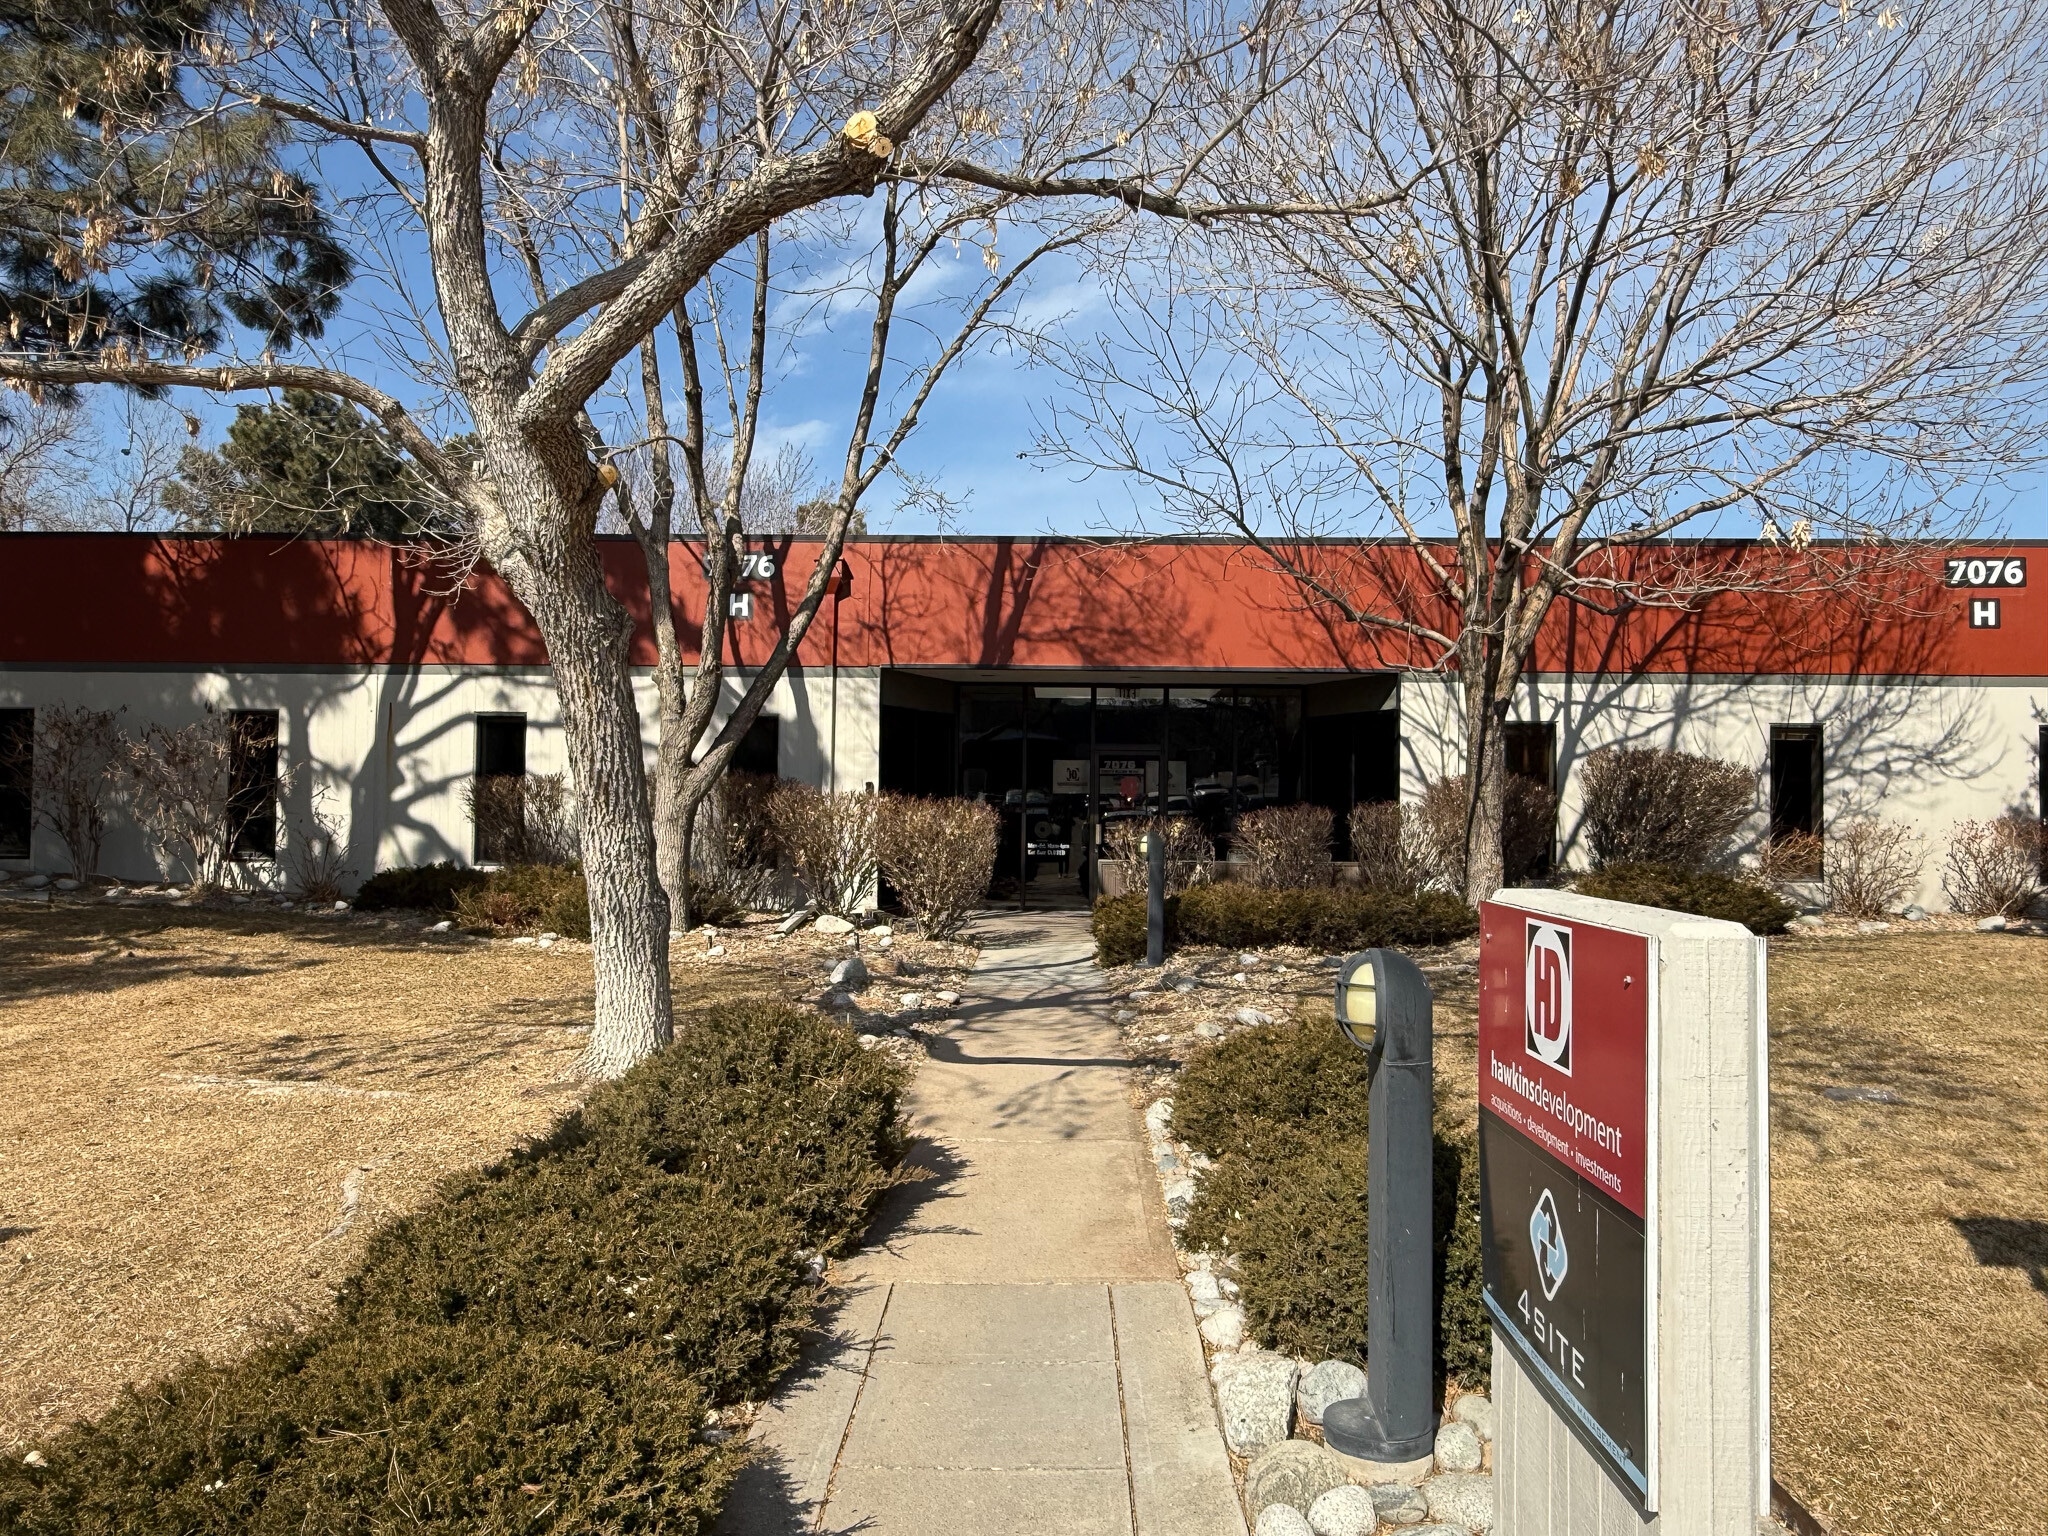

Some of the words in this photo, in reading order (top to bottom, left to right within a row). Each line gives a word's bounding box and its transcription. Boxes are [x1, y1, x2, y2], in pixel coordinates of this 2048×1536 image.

[1948, 559, 2024, 585] 7076
[729, 593, 749, 617] H
[1973, 601, 1996, 626] H
[1103, 760, 1136, 769] 7076
[1490, 1049, 1623, 1158] hawkinsdevelopment
[1490, 1093, 1523, 1125] acquisitions
[1527, 1115, 1569, 1157] development
[1575, 1147, 1622, 1193] investments
[1577, 1403, 1627, 1467] MANAGEMENT
